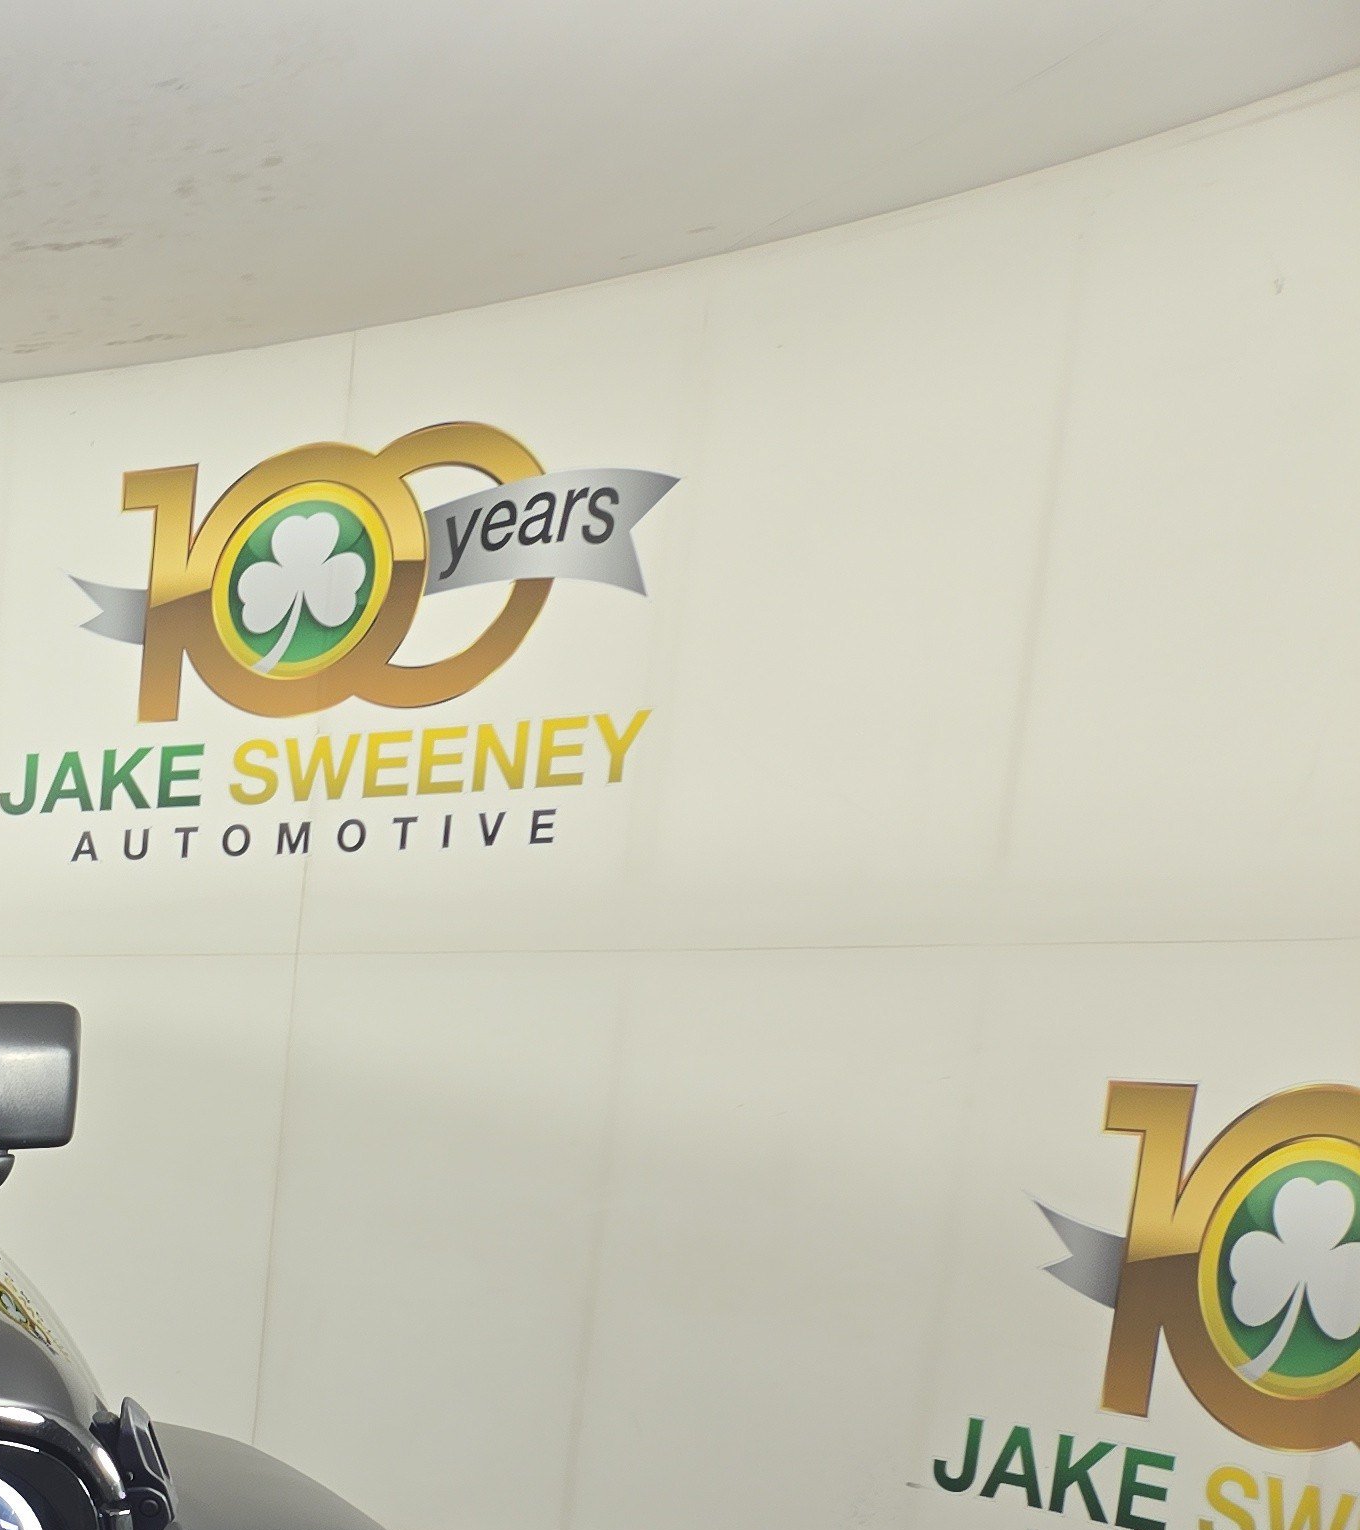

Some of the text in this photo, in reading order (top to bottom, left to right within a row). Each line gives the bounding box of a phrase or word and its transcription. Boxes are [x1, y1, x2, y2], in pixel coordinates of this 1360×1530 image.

[438, 485, 620, 581] years
[228, 708, 654, 806] SWEENEY
[71, 809, 558, 863] AUTOMOTIVE
